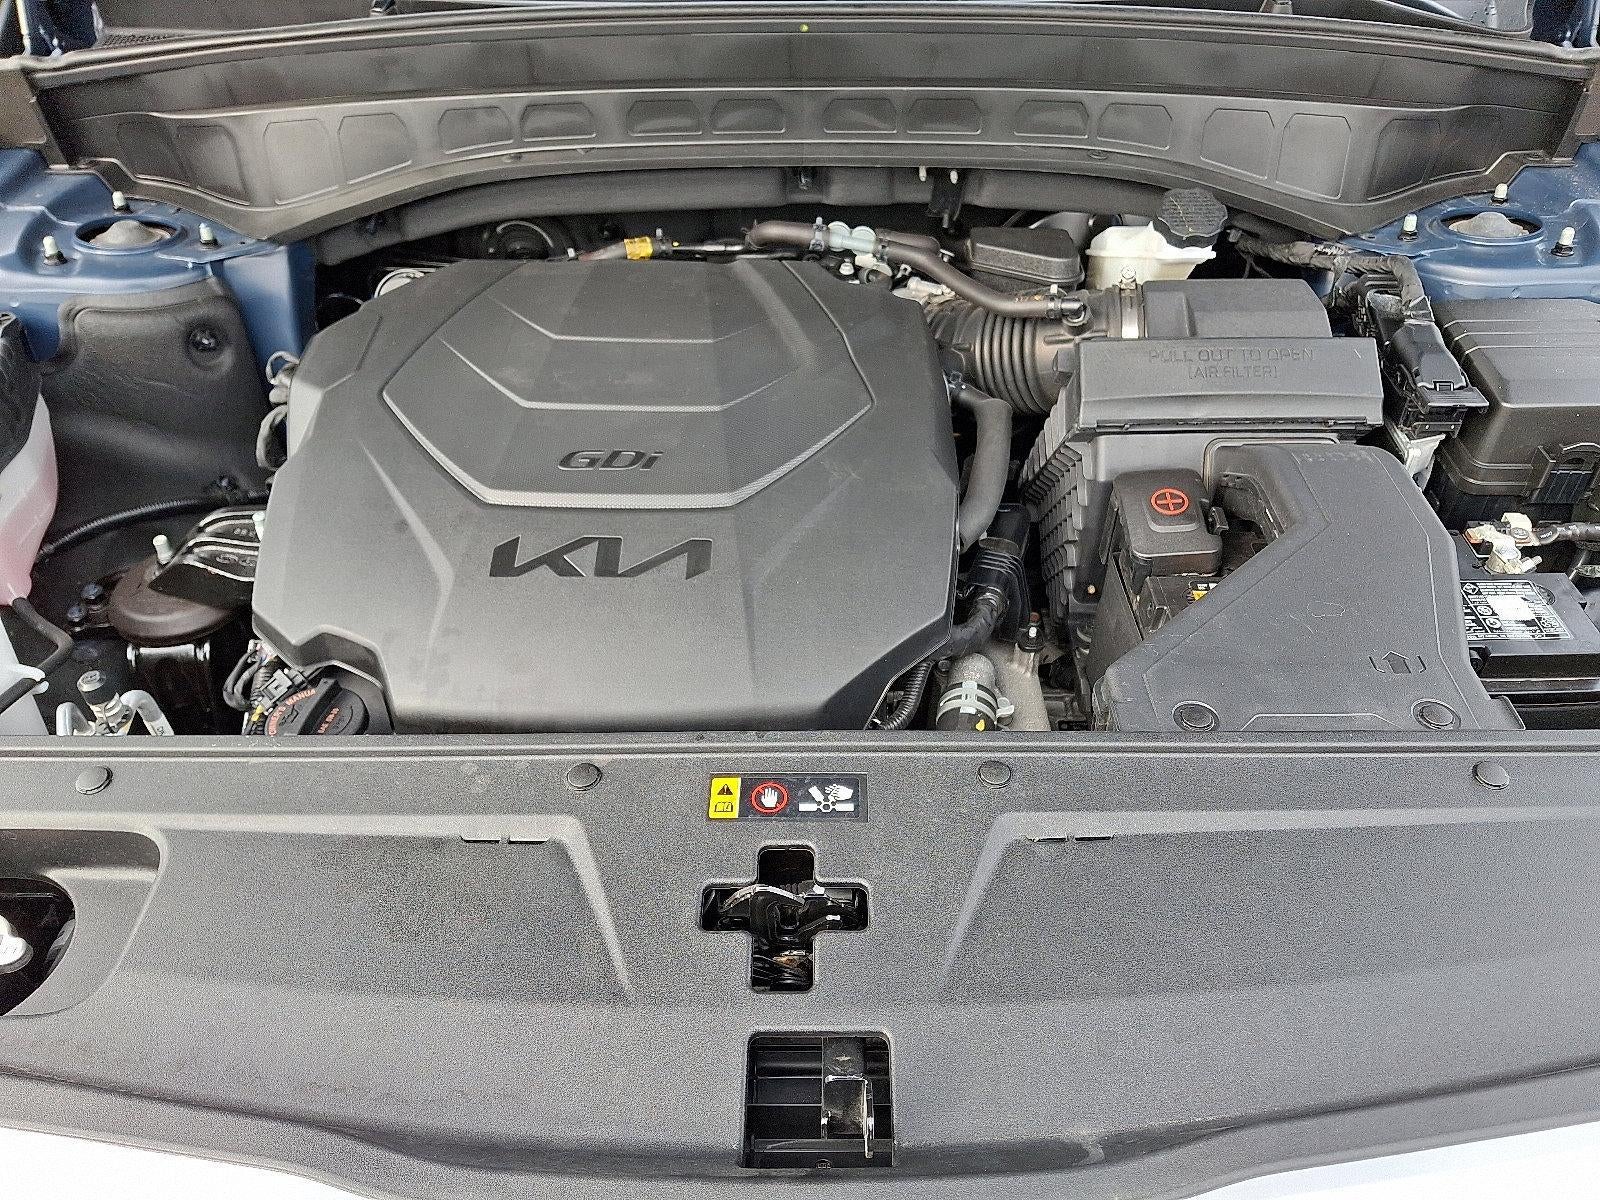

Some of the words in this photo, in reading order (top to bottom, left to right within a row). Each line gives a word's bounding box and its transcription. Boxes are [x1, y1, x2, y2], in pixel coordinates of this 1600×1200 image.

[1149, 349, 1193, 362] PULL
[1199, 348, 1234, 361] OUT
[1241, 348, 1261, 361] TO
[1267, 348, 1314, 361] OPEN
[558, 450, 664, 471] GDi
[489, 535, 713, 580] KIA
[286, 687, 317, 706] MANUA
